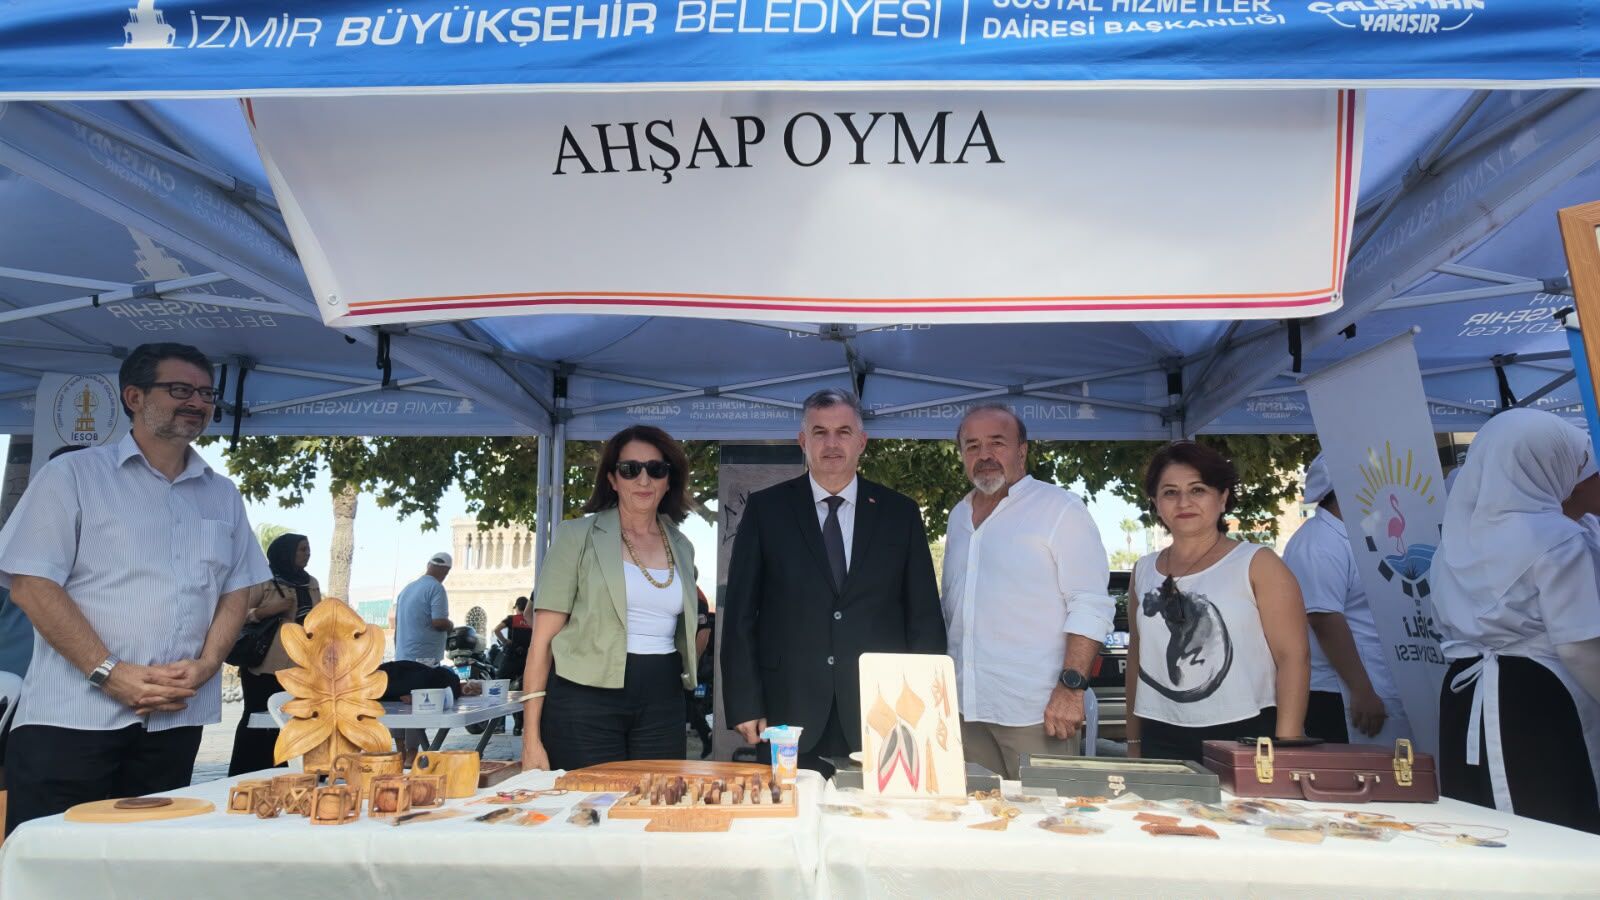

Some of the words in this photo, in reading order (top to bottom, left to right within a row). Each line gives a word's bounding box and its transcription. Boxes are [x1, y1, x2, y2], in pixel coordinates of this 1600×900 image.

[187, 11, 322, 49] İZMİR
[335, 1, 657, 48] BÜYÜKŞEHİR
[982, 13, 1095, 39] DAİRESİ
[1105, 14, 1286, 34] BAŞKANLIĞI
[1360, 13, 1440, 34] YAKIŞIR
[552, 115, 766, 184] AHŞAP
[783, 109, 1006, 168] OYMA
